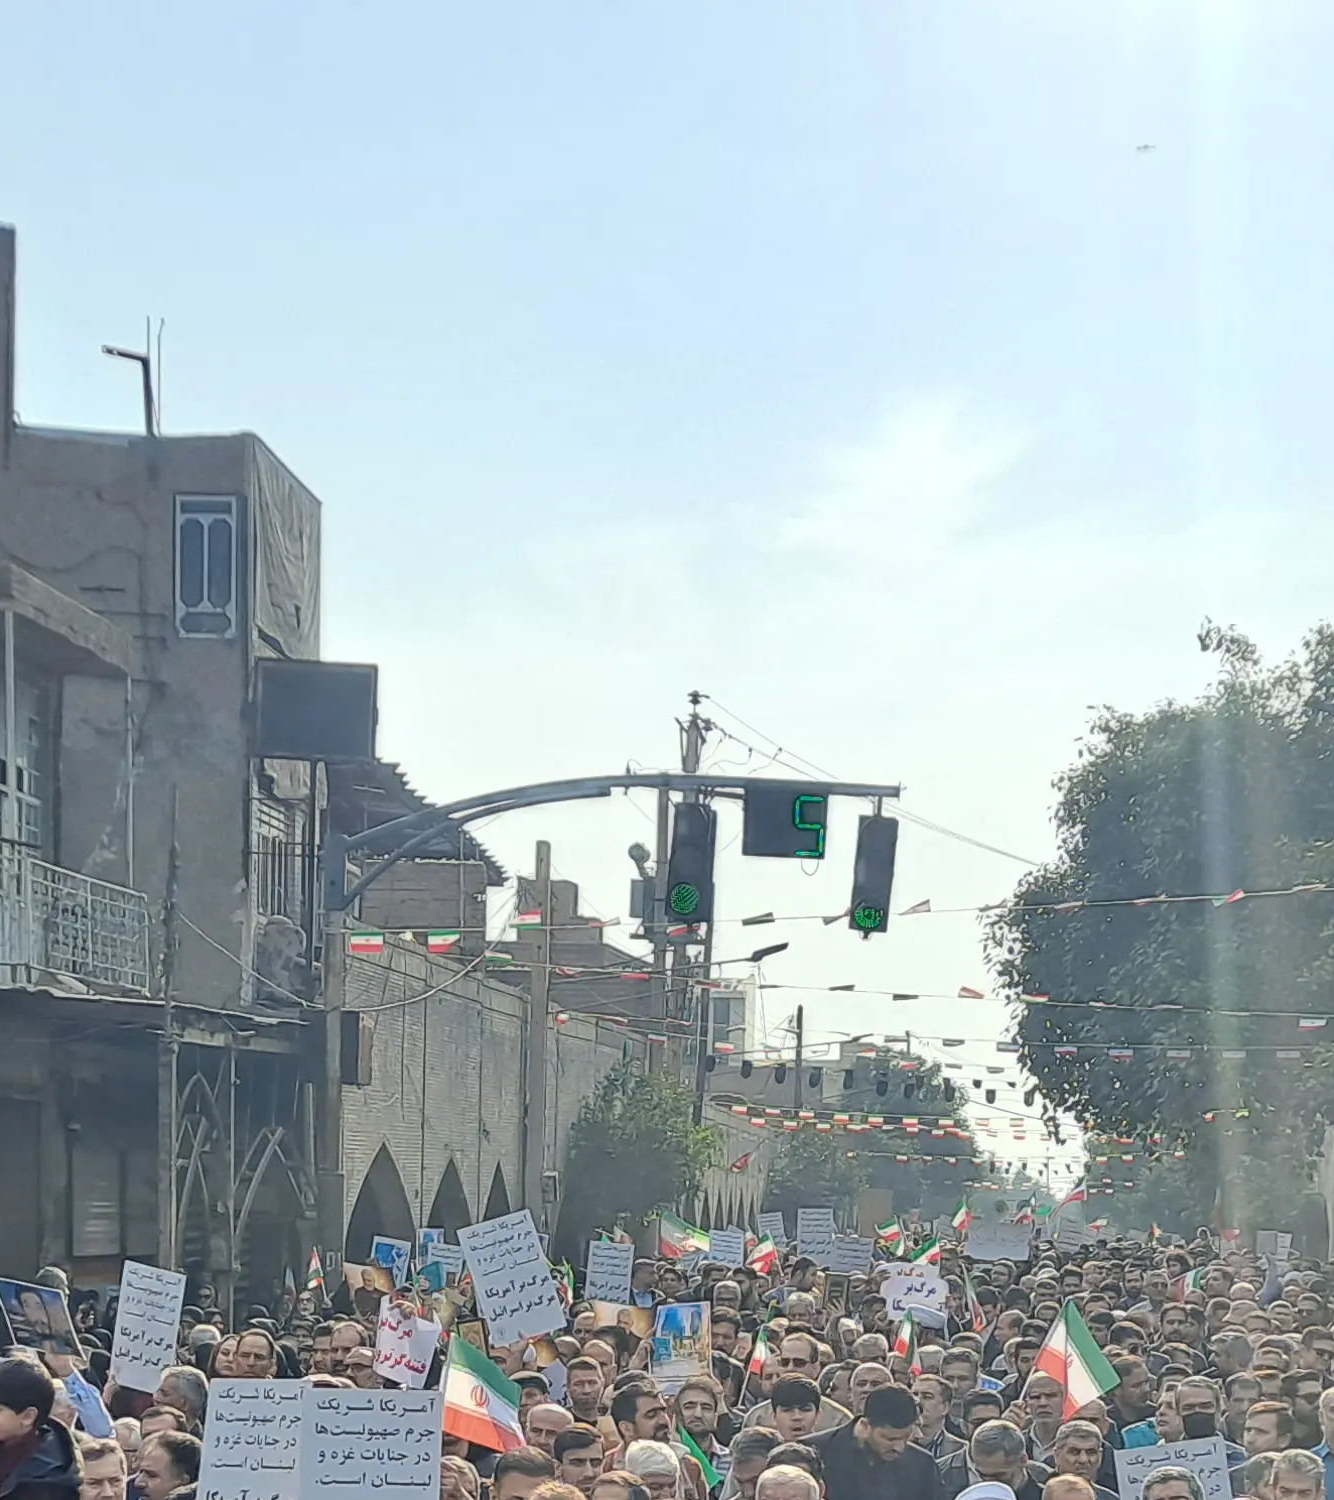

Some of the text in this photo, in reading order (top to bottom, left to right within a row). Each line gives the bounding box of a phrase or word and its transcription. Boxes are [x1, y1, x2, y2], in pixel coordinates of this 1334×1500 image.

[794, 795, 824, 857] 5
[218, 1386, 305, 1406] آمریکا شریک
[316, 1398, 437, 1418] آمریکا شریک
[278, 1413, 302, 1429] جرم
[214, 1433, 297, 1451] در جنایات غزه و
[404, 1427, 436, 1443] جرم
[317, 1446, 431, 1466] در جنایات غزه و
[1174, 1443, 1217, 1463] آمریکا
[250, 1457, 296, 1474] لبنان
[1198, 1467, 1222, 1479] جرم
[371, 1472, 432, 1492] لبنان
